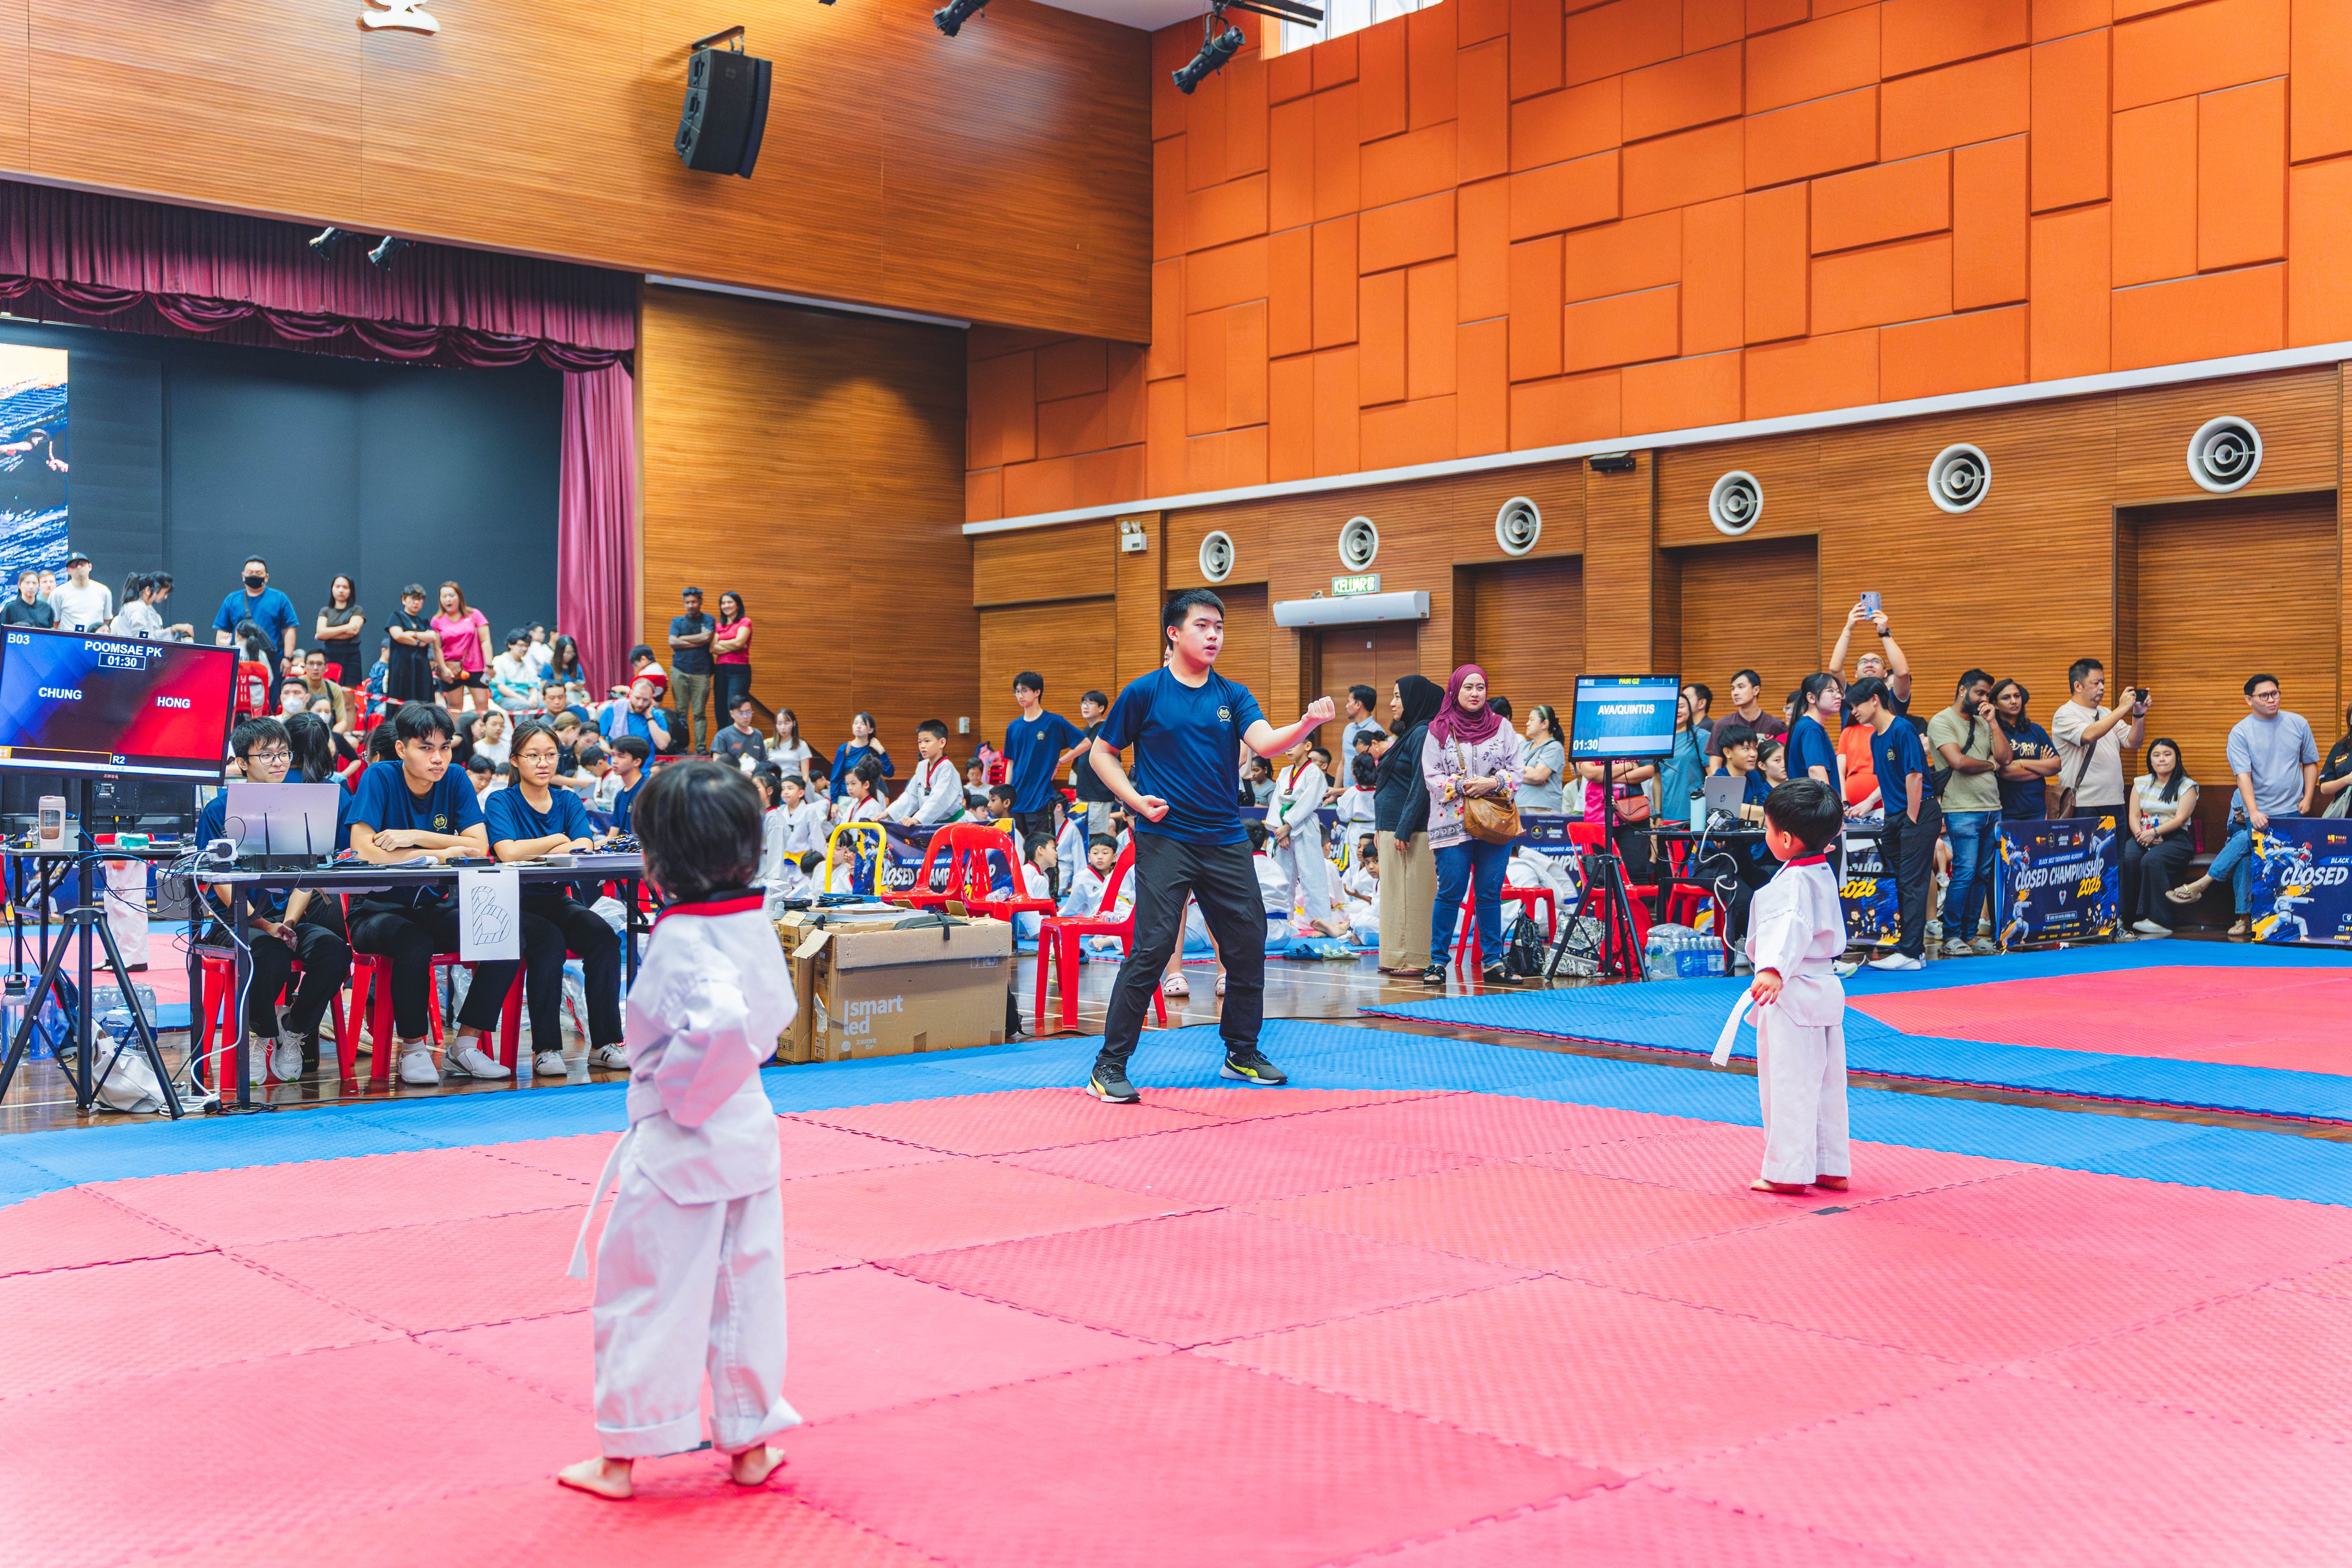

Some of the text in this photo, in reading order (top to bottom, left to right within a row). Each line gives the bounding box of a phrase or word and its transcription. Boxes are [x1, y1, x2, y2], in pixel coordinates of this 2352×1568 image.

[1334, 577, 1367, 594] KELUAR
[7, 633, 30, 644] B03
[85, 641, 162, 657] POOMSAE PK
[107, 655, 137, 668] 01:30
[39, 687, 82, 700] CHUNG
[157, 697, 190, 708] HONG
[1597, 704, 1655, 715] AVA/QUINTUS
[1573, 739, 1598, 751] 01:30
[112, 756, 125, 764] R2
[875, 867, 914, 886] LOSED
[2015, 858, 2105, 892] CLOSED CHAMPIONSHIP
[2280, 867, 2348, 886] CLOSED
[2077, 875, 2101, 899] 2026
[850, 995, 903, 1017] smart
